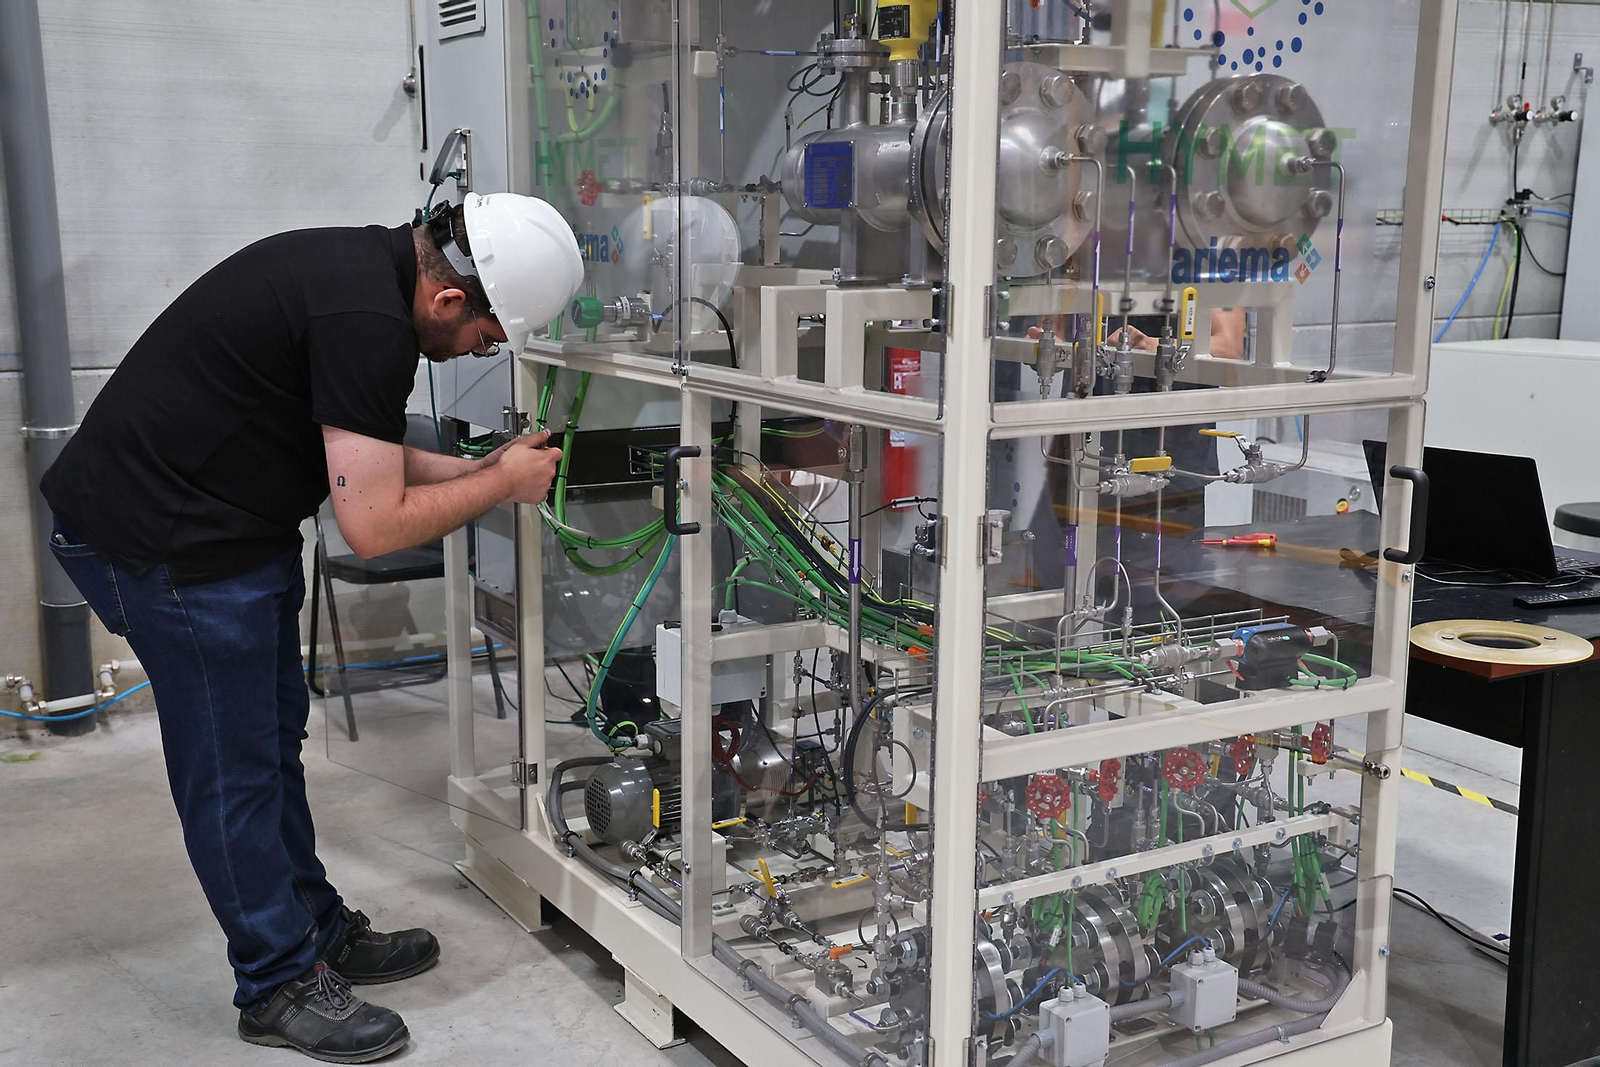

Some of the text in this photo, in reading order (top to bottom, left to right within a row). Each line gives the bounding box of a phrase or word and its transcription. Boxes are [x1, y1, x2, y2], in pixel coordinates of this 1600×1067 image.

[535, 138, 638, 186] HYMET
[1117, 119, 1356, 187] HYMET
[1172, 236, 1289, 283] ariema
